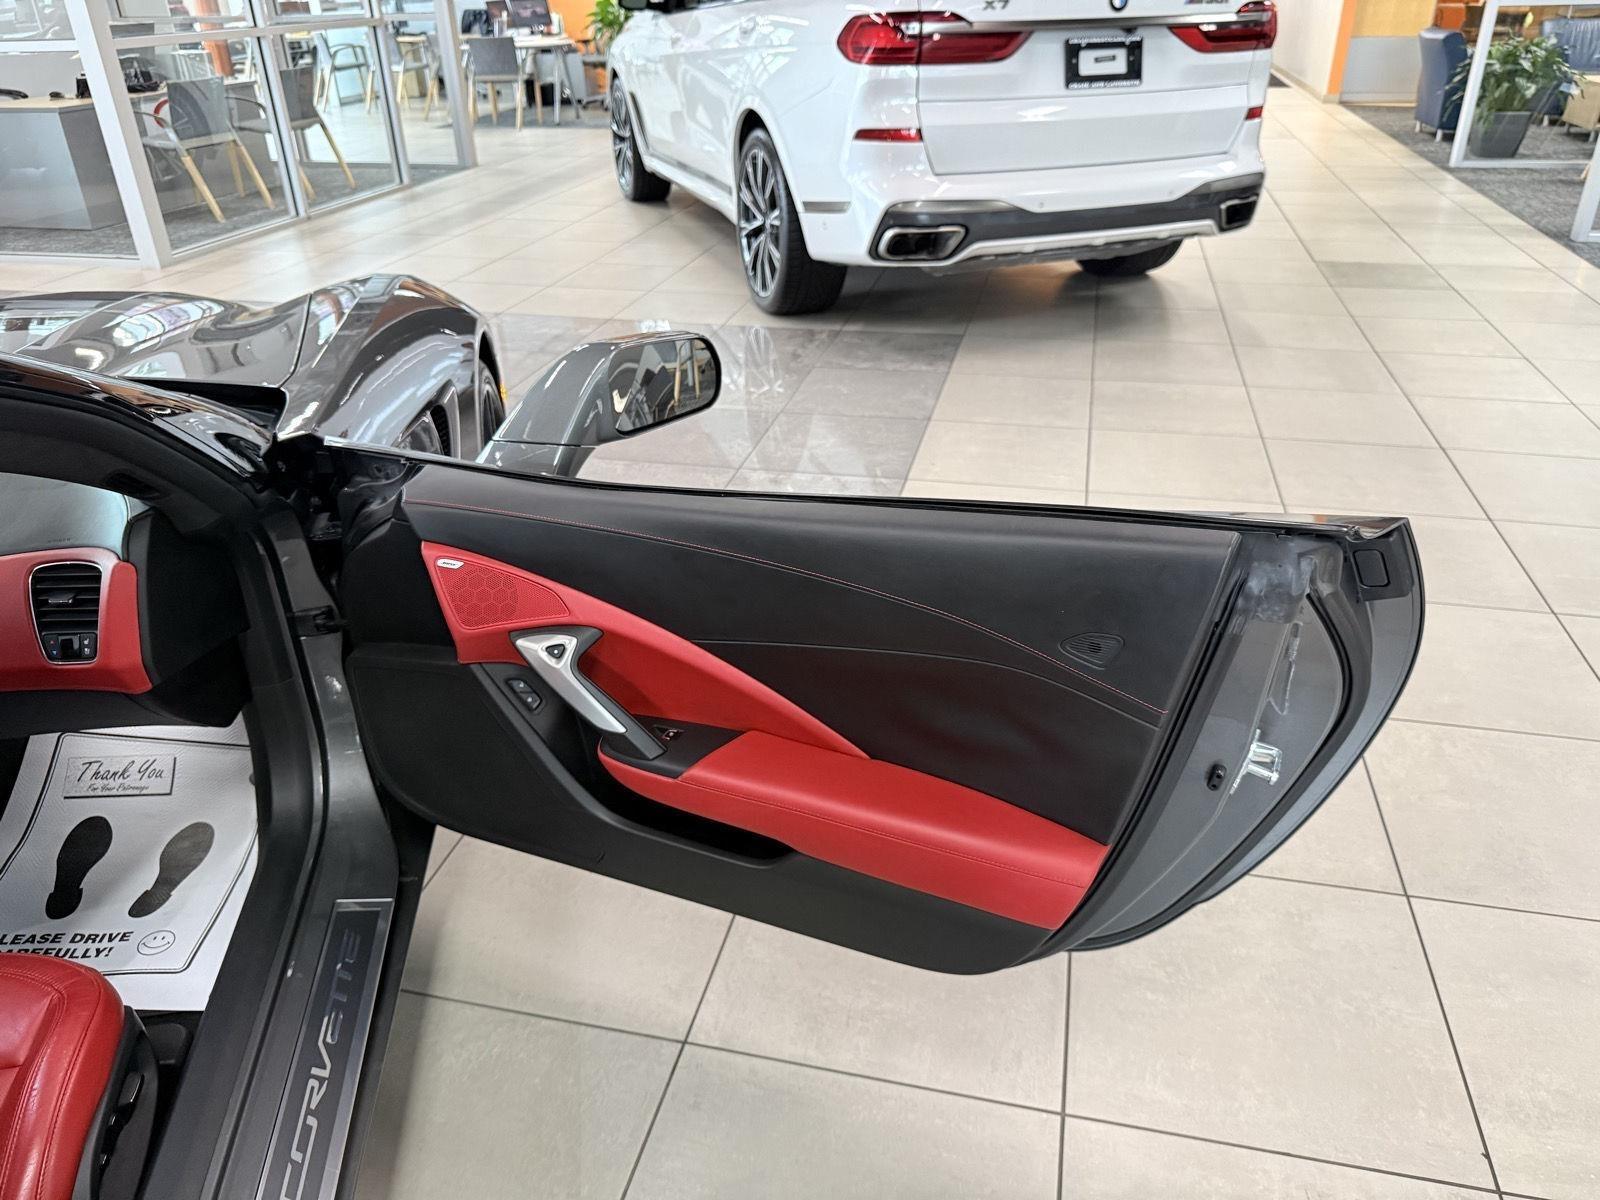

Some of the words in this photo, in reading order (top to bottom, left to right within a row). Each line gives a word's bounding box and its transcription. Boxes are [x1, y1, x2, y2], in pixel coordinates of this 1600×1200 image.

[983, 0, 1010, 11] X7
[77, 760, 136, 782] Thank
[137, 758, 166, 781] You
[0, 933, 66, 945] LEASE
[69, 931, 134, 944] DRIVE
